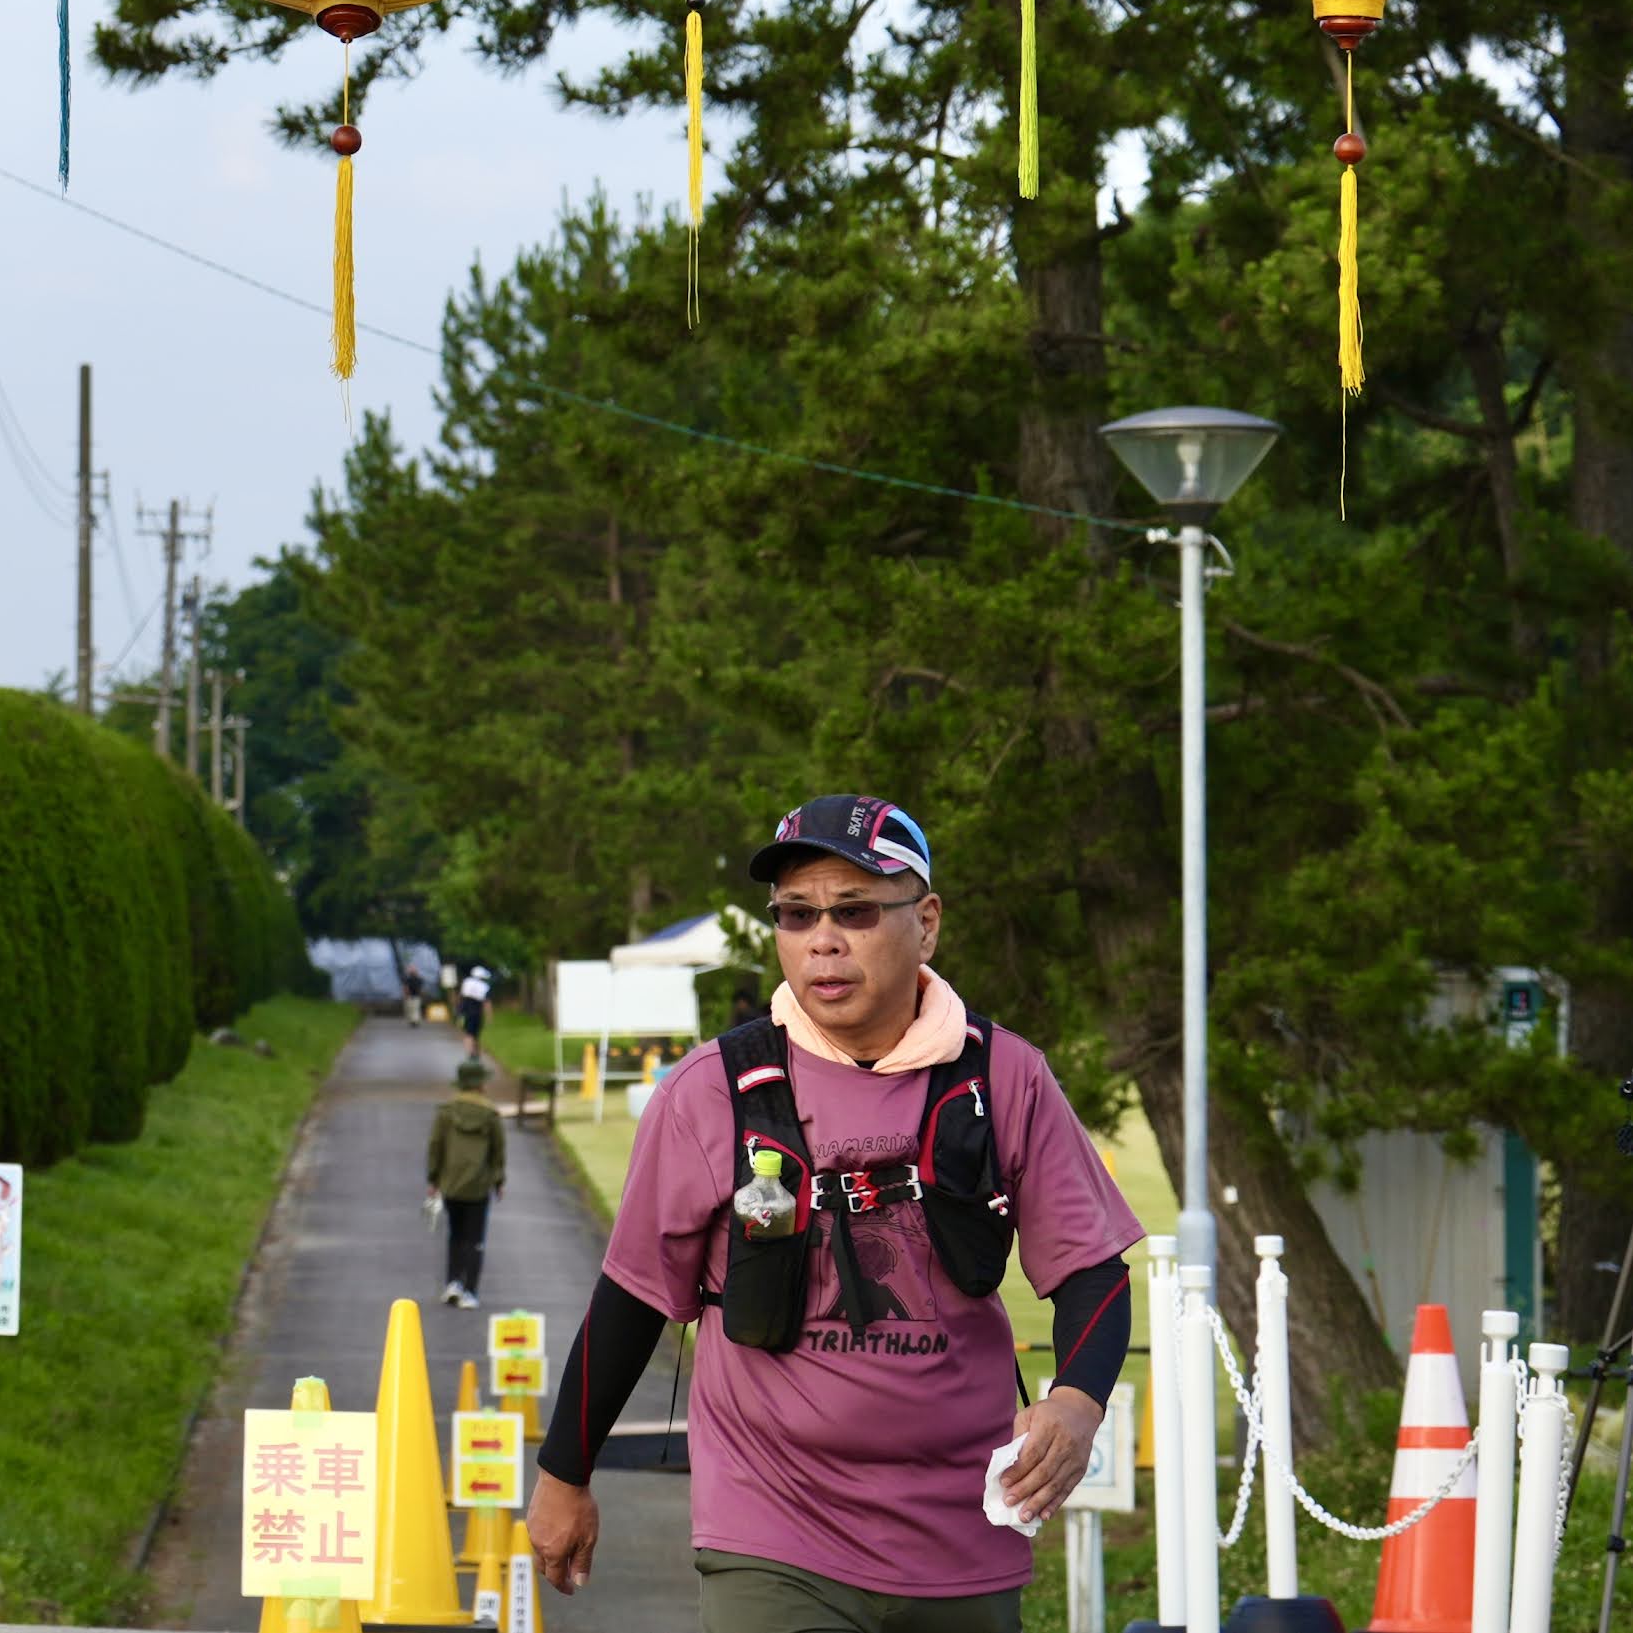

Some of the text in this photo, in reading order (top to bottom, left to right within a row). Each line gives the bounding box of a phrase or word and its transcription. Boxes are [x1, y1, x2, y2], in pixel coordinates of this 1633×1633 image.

[806, 1329, 949, 1355] TRIATHLON
[251, 1442, 366, 1498] 乗車
[251, 1509, 365, 1565] 禁止
